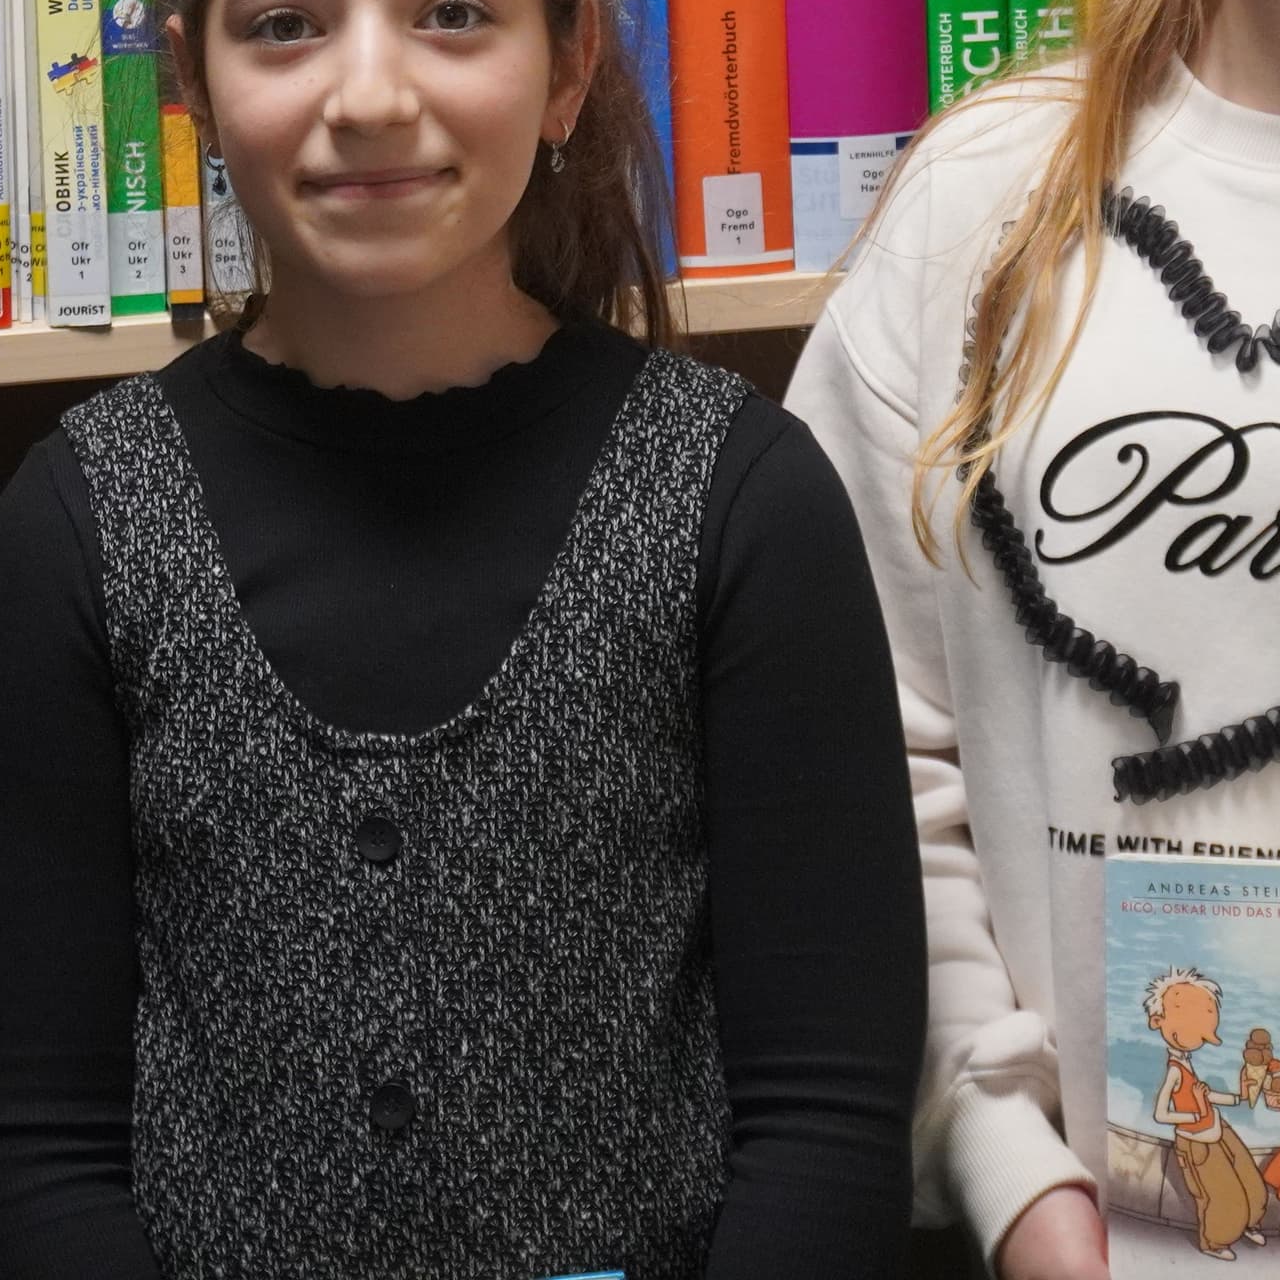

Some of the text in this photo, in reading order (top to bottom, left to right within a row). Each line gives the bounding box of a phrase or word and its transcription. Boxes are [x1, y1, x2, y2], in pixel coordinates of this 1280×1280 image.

[721, 10, 742, 175] Fremdwörterbuch
[720, 220, 756, 232] Fremd
[1048, 827, 1105, 857] TIME
[1117, 834, 1183, 858] WITH
[1147, 882, 1232, 897] ANDREAS
[1121, 901, 1157, 916] RICO,
[1162, 902, 1208, 916] OSKAR
[1212, 904, 1243, 918] UND
[1246, 906, 1273, 919] DAS
